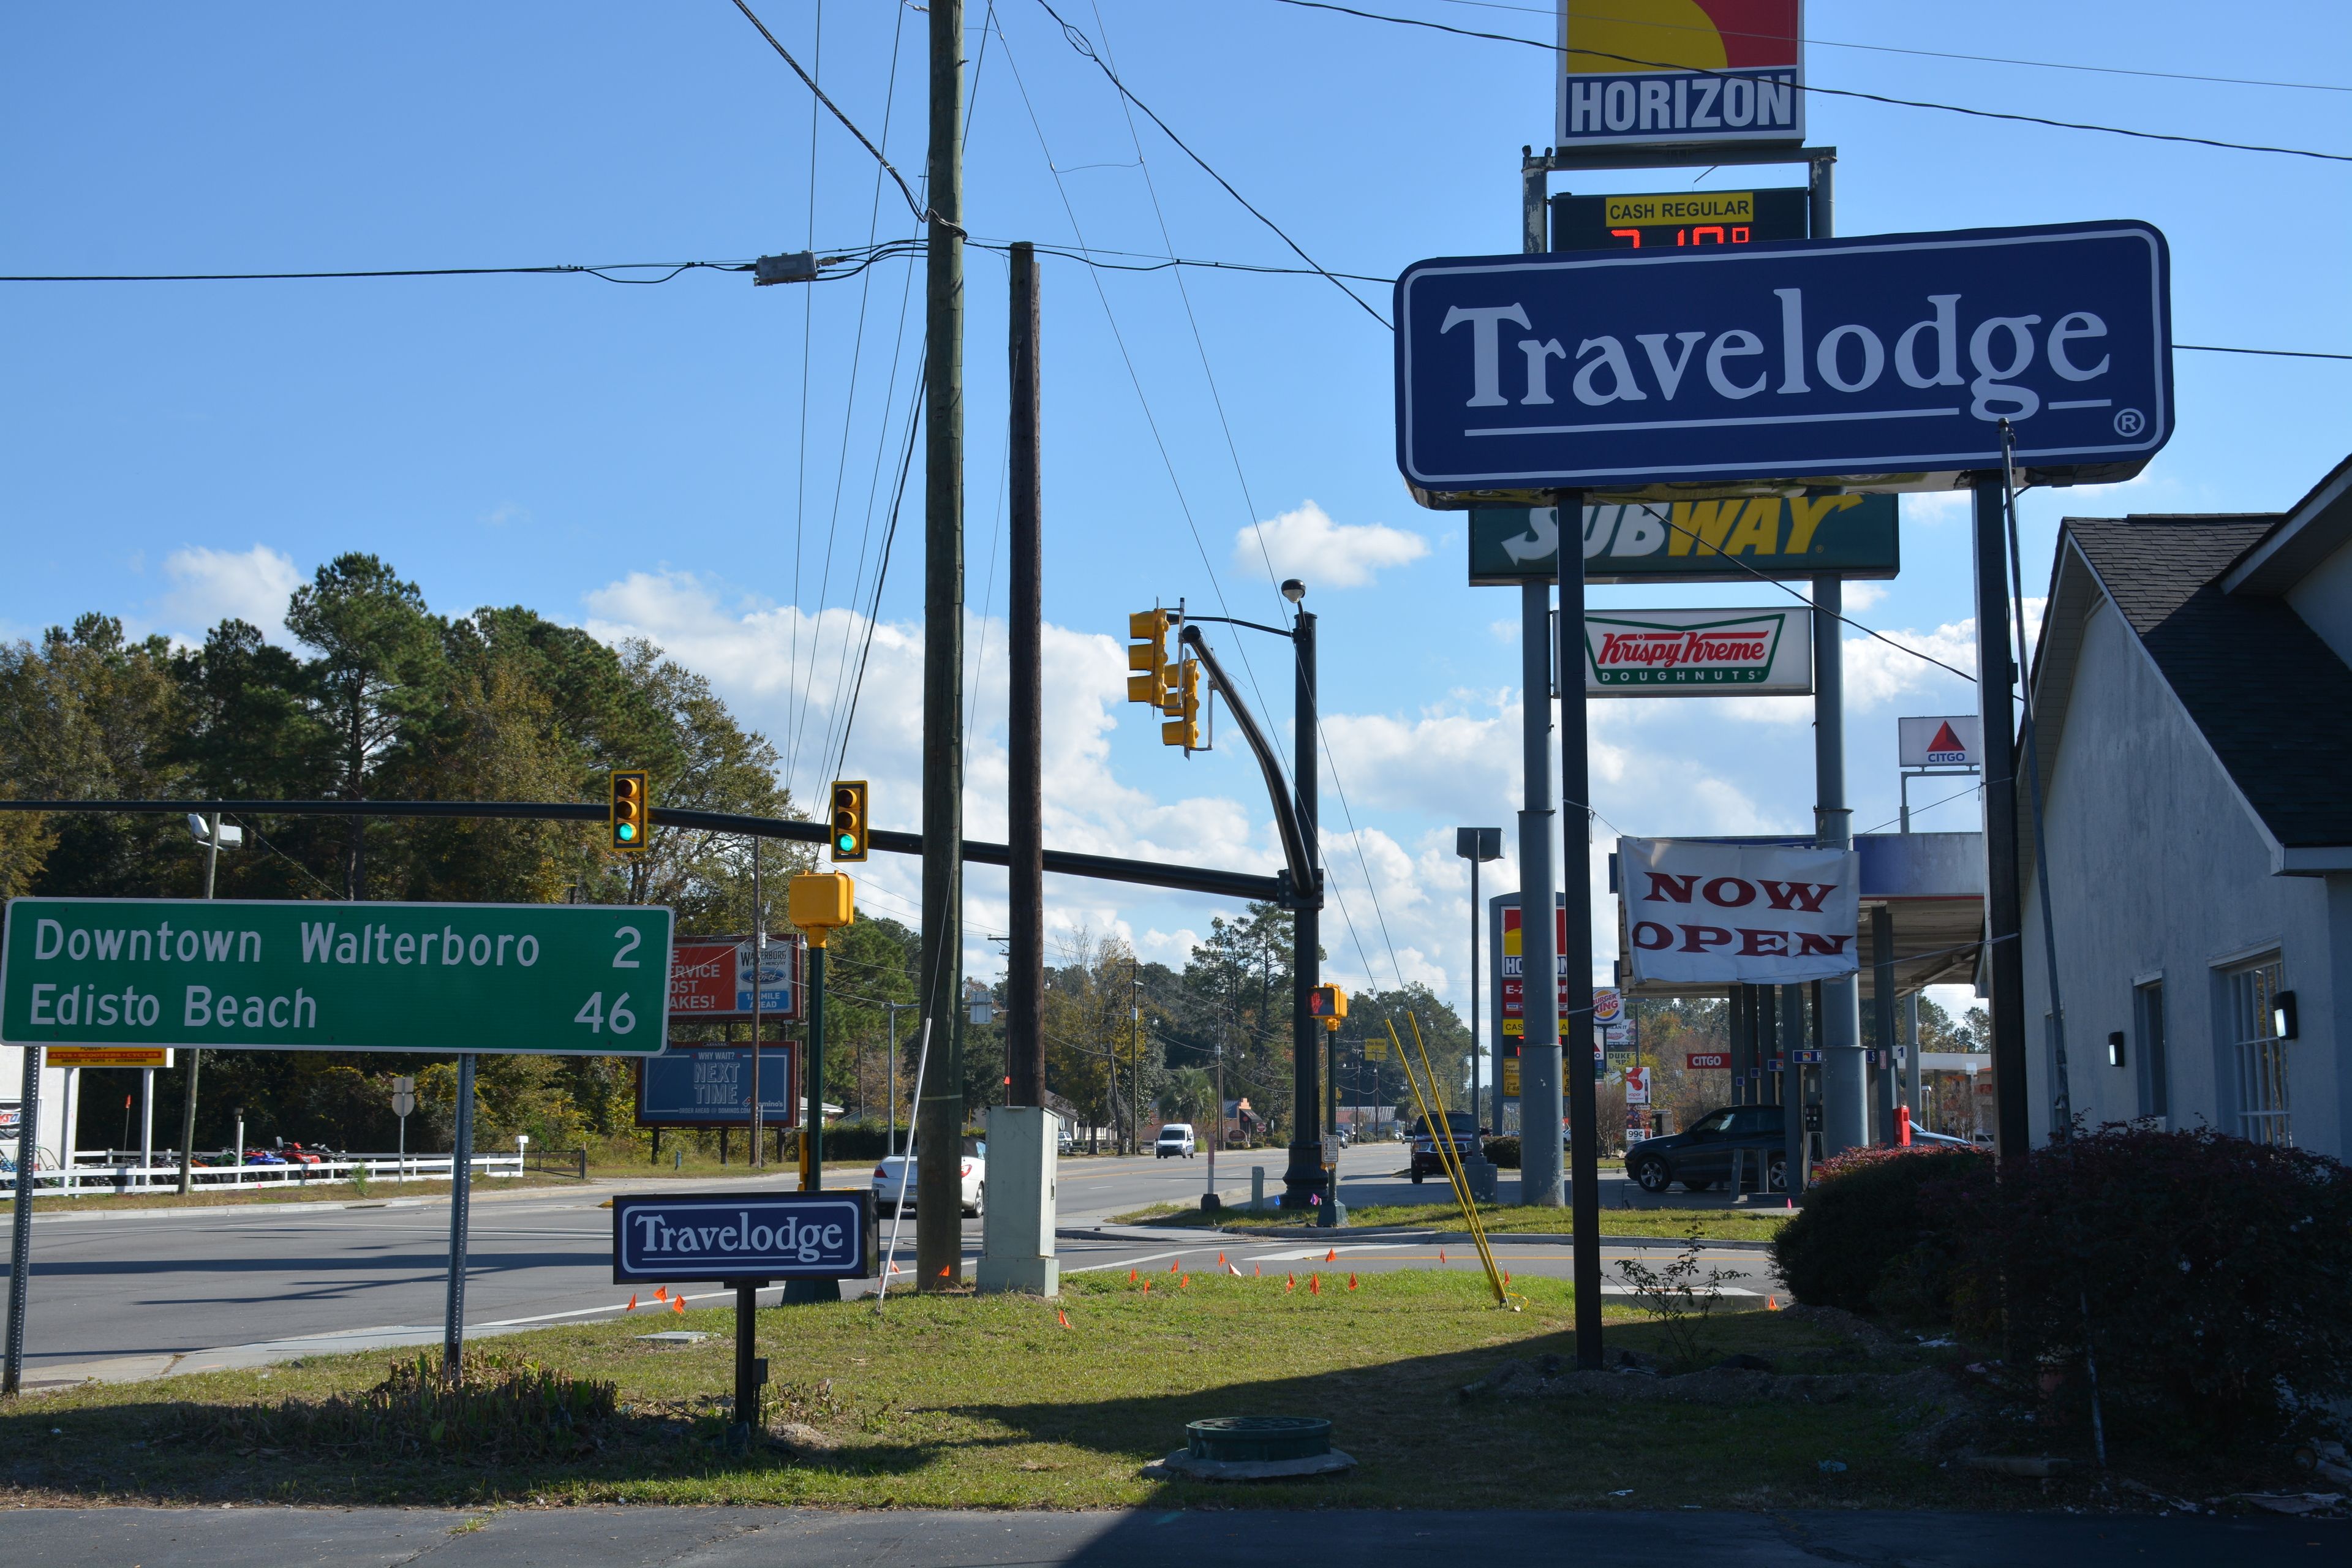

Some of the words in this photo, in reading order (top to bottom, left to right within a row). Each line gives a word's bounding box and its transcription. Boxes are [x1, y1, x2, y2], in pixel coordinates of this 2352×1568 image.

[1571, 75, 1791, 132] HORIZON
[1610, 203, 1654, 219] CASH
[1662, 200, 1749, 217] REGULAR
[1440, 288, 2111, 421] Travelodge
[1597, 631, 1685, 668] Krispy
[1681, 630, 1770, 663] Kreme
[1602, 670, 1755, 681] DOUGHNUTS
[1928, 753, 1965, 762] CITGO
[1643, 872, 1838, 913] NOW
[36, 918, 262, 962] Downtown
[301, 921, 540, 967] Walterboro
[614, 925, 641, 968] 2
[1632, 921, 1854, 957] OPEN
[741, 950, 786, 967] WAERBORO
[670, 980, 698, 993] OST
[669, 995, 715, 1009] AKES!
[1593, 993, 1617, 1005] BURGER
[1593, 999, 1618, 1014] KING
[30, 983, 160, 1025] Edisto
[184, 986, 317, 1028] Beach
[574, 992, 636, 1035] 46
[698, 1052, 714, 1060] WHY
[715, 1052, 735, 1060] WAIT?
[1692, 1055, 1722, 1066] CITGO
[1898, 1047, 1904, 1057] 1
[693, 1062, 740, 1083] NEXT
[693, 1084, 737, 1104] TIME
[635, 1212, 843, 1262] Travelodge
